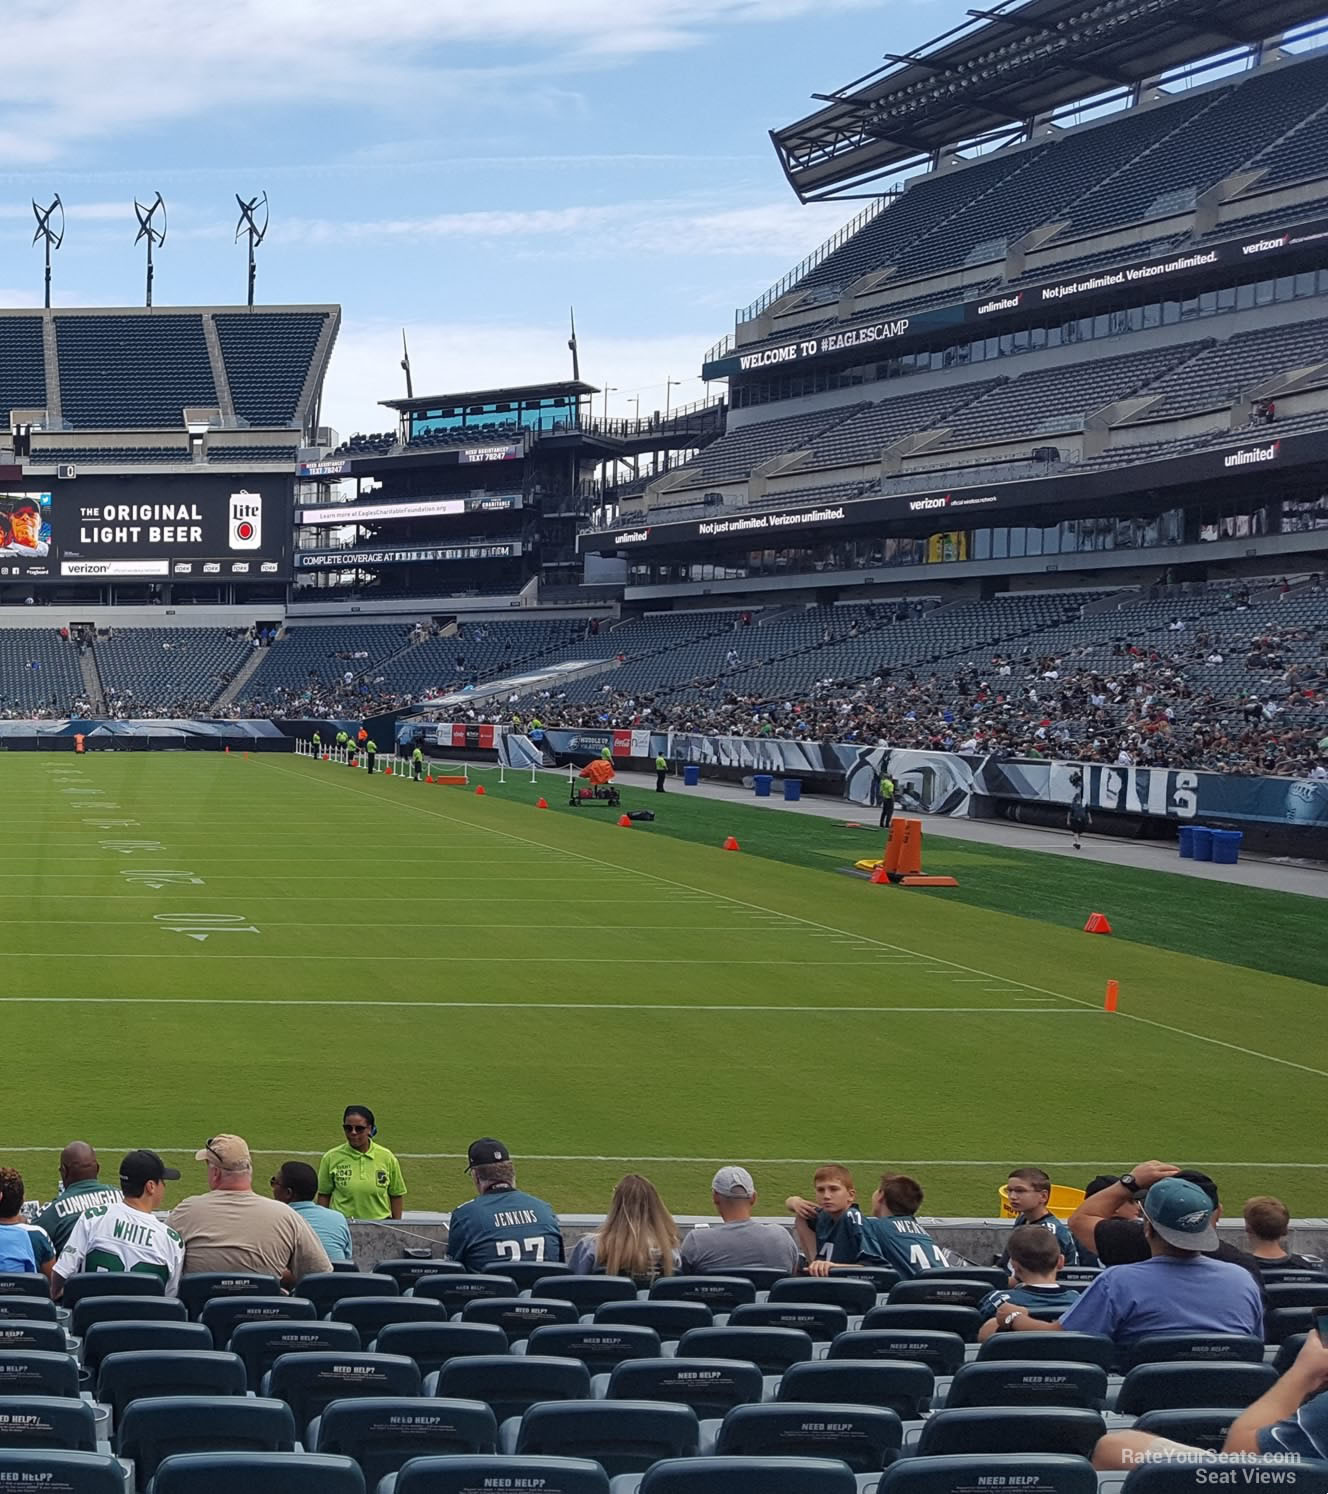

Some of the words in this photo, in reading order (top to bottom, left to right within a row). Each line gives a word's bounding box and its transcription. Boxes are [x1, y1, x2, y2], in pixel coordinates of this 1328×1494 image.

[1242, 236, 1283, 255] verizon
[1042, 288, 1059, 300] Not
[1059, 283, 1078, 299] just
[1078, 271, 1126, 292] unlimited.
[1126, 263, 1164, 281] Verizon
[1164, 251, 1218, 272] unlimited.
[977, 296, 1019, 315] unlimited
[740, 344, 797, 370] WELCOME
[801, 340, 817, 357] TO
[821, 319, 909, 352] #EAGLESCAMP
[468, 454, 485, 462] TEXT
[1224, 445, 1275, 467] unlimited
[309, 467, 324, 475] TEXT
[232, 504, 260, 520] Lite
[910, 497, 945, 511] verizon
[80, 507, 99, 516] THE
[103, 504, 202, 521] ORIGINAL
[699, 522, 713, 534] Not
[713, 519, 728, 535] just
[729, 515, 769, 532] unlimited.
[769, 512, 801, 527] Verizon
[801, 507, 845, 523] unlimited.
[80, 527, 141, 543] LIGHT
[149, 526, 202, 543] BEER
[615, 530, 648, 544] unlimited
[303, 555, 342, 565] COMPLETE
[343, 554, 383, 565] COVERAGE
[383, 553, 394, 562] AT
[68, 563, 107, 573] verizon
[494, 1210, 538, 1227] JENKINS
[113, 1218, 156, 1247] WHITE
[12, 1415, 37, 1424] HELP?
[390, 1416, 412, 1424] NEED
[415, 1416, 440, 1424] HELP?
[485, 1478, 512, 1487] NEED
[515, 1479, 545, 1488] HELP?
[979, 1476, 1006, 1485] NEED
[1008, 1476, 1039, 1485] HELP?
